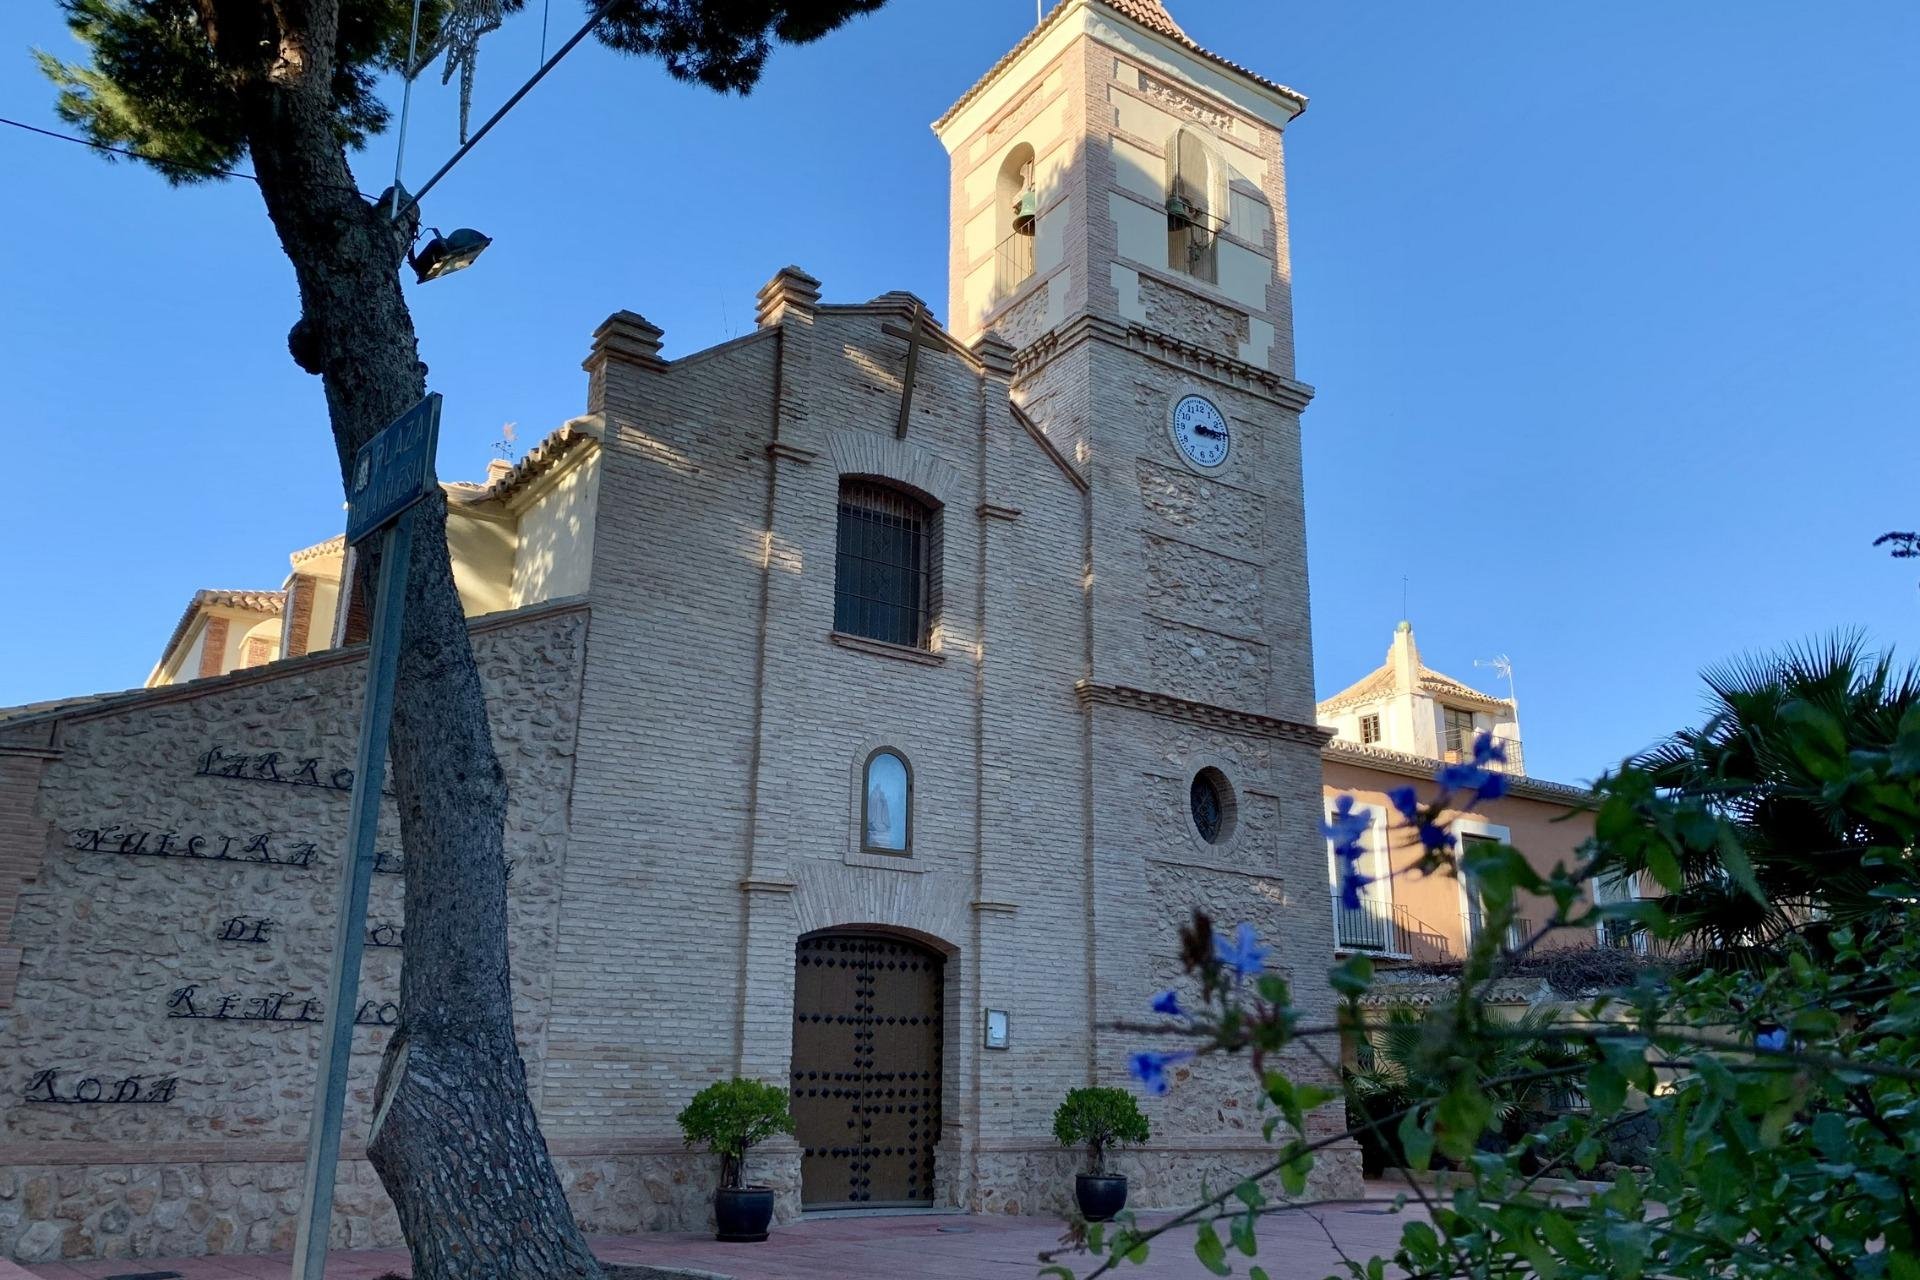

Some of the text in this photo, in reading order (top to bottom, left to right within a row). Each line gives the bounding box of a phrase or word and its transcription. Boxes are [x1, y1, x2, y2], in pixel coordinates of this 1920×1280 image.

[1187, 405, 1195, 414] 11
[1195, 404, 1205, 414] 12
[1182, 412, 1191, 421] 10
[1180, 422, 1186, 430] 9
[1213, 421, 1218, 429] 2
[1183, 434, 1189, 442] 8
[376, 414, 424, 473] PLAZA
[1214, 444, 1219, 452] 4
[1190, 445, 1196, 453] 7
[1200, 451, 1205, 459] 6
[1209, 450, 1214, 458] 5
[381, 456, 423, 508] IGLESIA
[197, 746, 355, 791] PARRO
[76, 825, 318, 865] NUESTRA
[217, 915, 274, 942] DE
[25, 1066, 179, 1103] RODA
